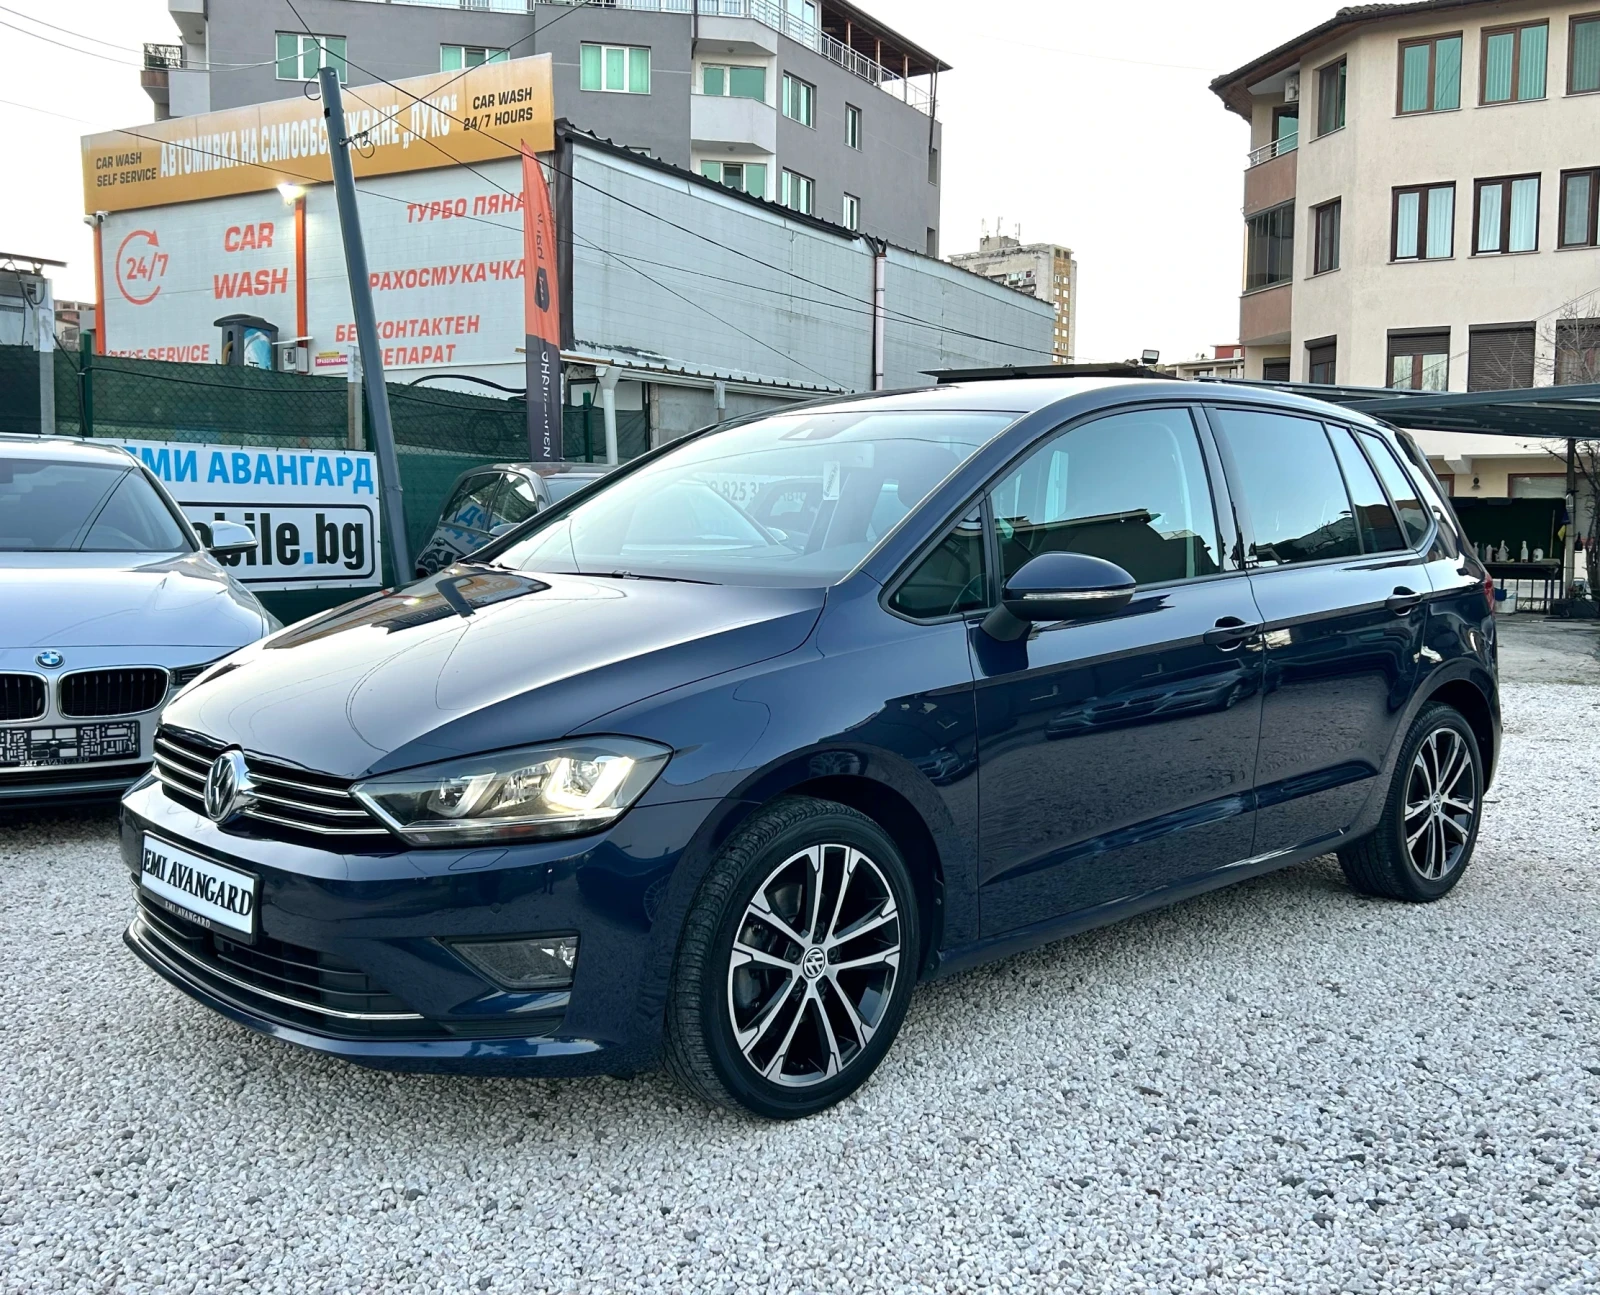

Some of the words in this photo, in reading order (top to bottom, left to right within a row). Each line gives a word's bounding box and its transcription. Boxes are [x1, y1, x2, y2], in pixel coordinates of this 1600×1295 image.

[473, 93, 495, 110] CAR
[498, 87, 532, 105] WASH
[463, 114, 491, 131] 24/7
[494, 107, 533, 126] HOURS
[160, 127, 239, 178] АВТОМИВКА
[241, 127, 259, 166] НА
[261, 104, 399, 163] САМООБСЖВАНЕ
[96, 154, 114, 170] CAR
[115, 152, 142, 167] WASH
[97, 169, 118, 187] SELF
[120, 167, 157, 184] SERVICE
[407, 197, 467, 223] ТУРБО
[472, 191, 525, 216] ПЯНА
[224, 222, 275, 253] CAR
[126, 252, 169, 282] 24/7
[369, 258, 525, 291] РАХОСМУКАЧКА
[213, 267, 289, 300] WASH
[335, 314, 481, 343] БЕОНТАКТЕН
[379, 344, 456, 366] ЕПАРАТ
[207, 452, 374, 494] АВАНГАРД
[191, 512, 365, 570] ile.bg
[142, 847, 168, 881] EMI
[166, 861, 254, 917] AVANGARD
[165, 900, 178, 913] EMI
[178, 905, 211, 928] AVANGARD
